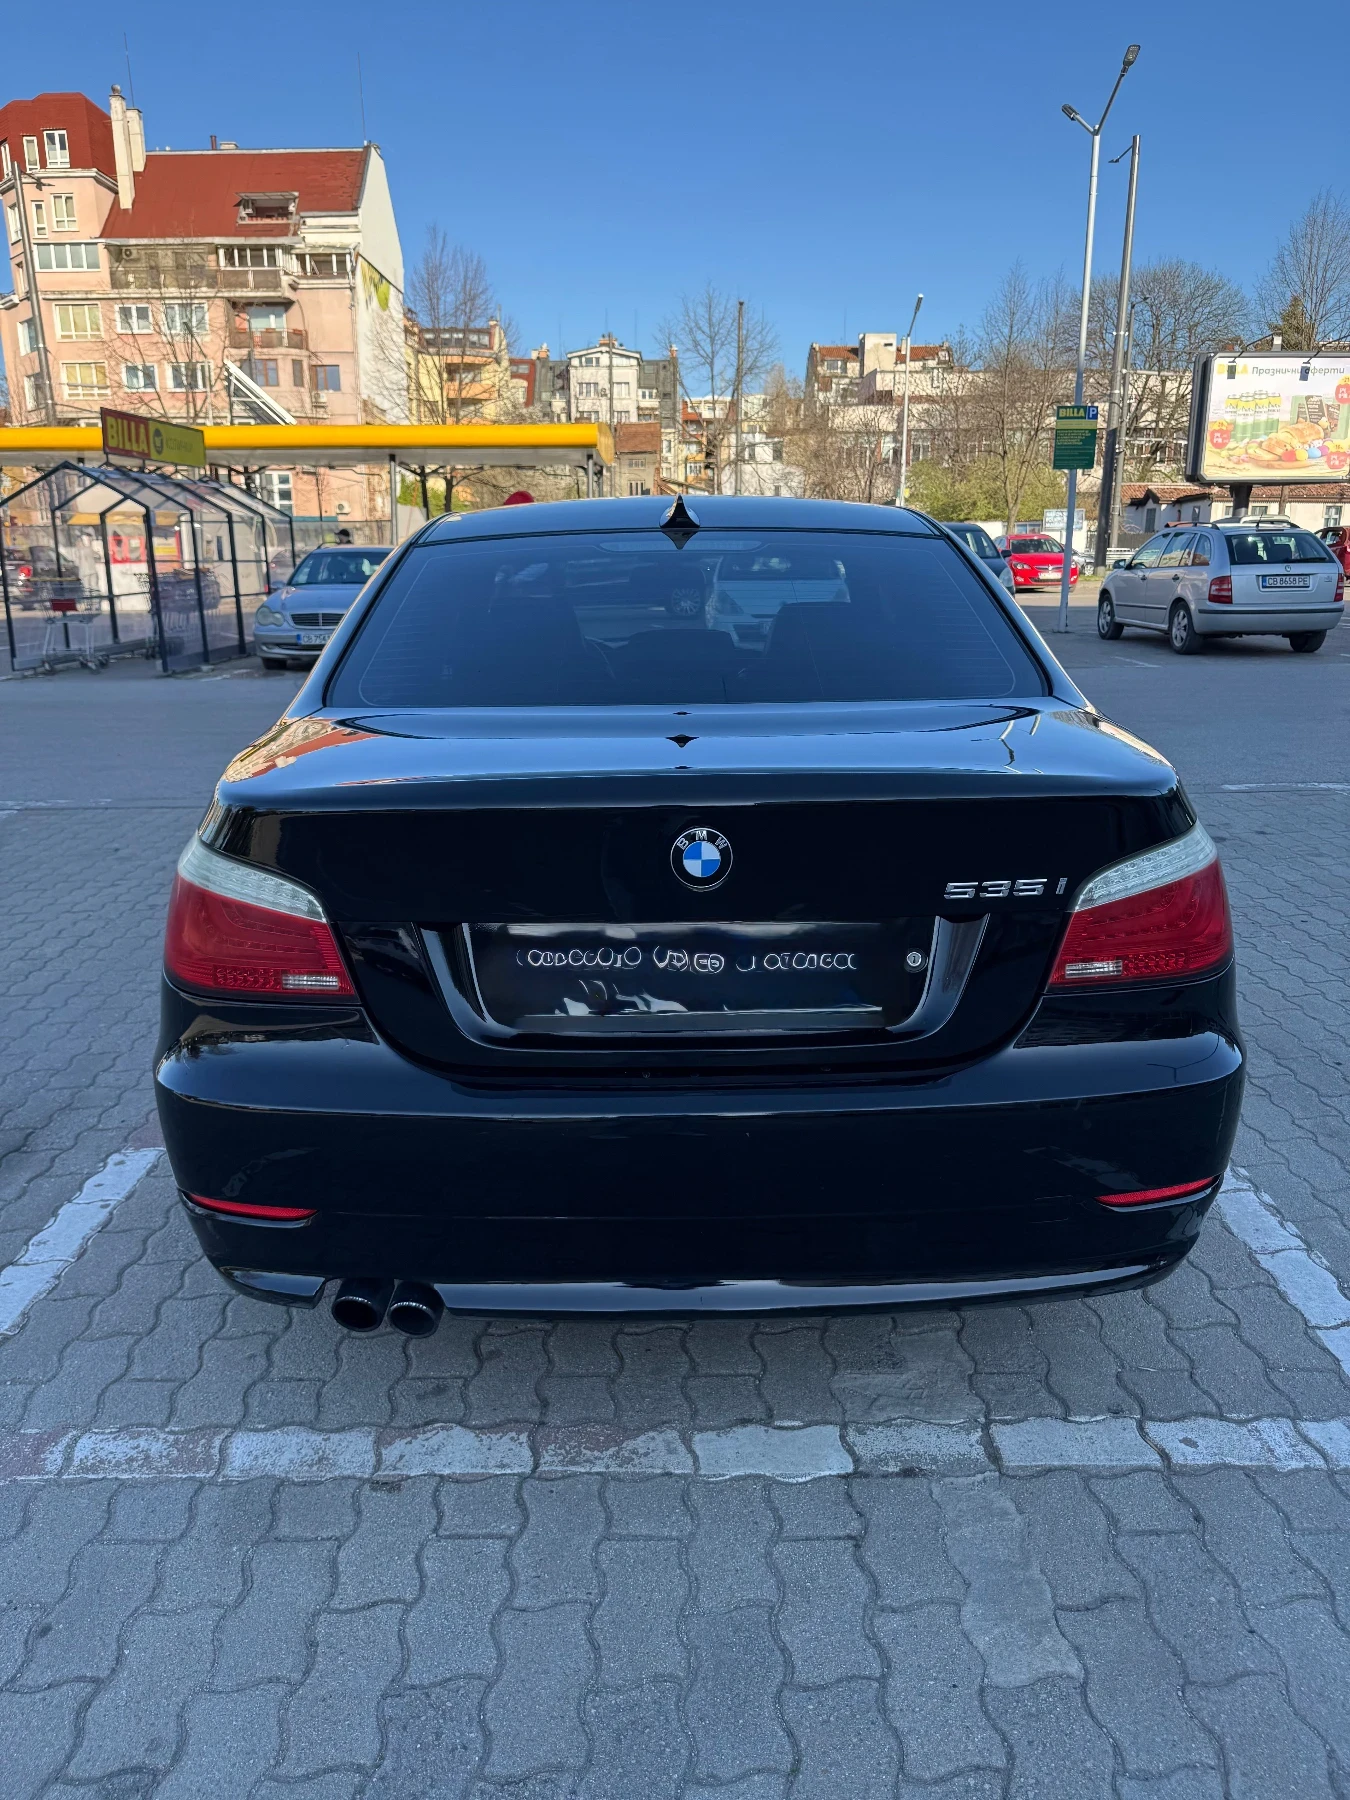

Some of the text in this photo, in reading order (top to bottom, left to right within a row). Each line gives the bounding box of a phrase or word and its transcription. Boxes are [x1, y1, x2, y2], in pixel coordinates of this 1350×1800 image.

[1059, 408, 1085, 417] BILLA
[1089, 407, 1097, 418] P
[106, 416, 149, 453] BILLA
[1267, 577, 1308, 586] CB 8658 PE
[677, 830, 728, 850] BMW
